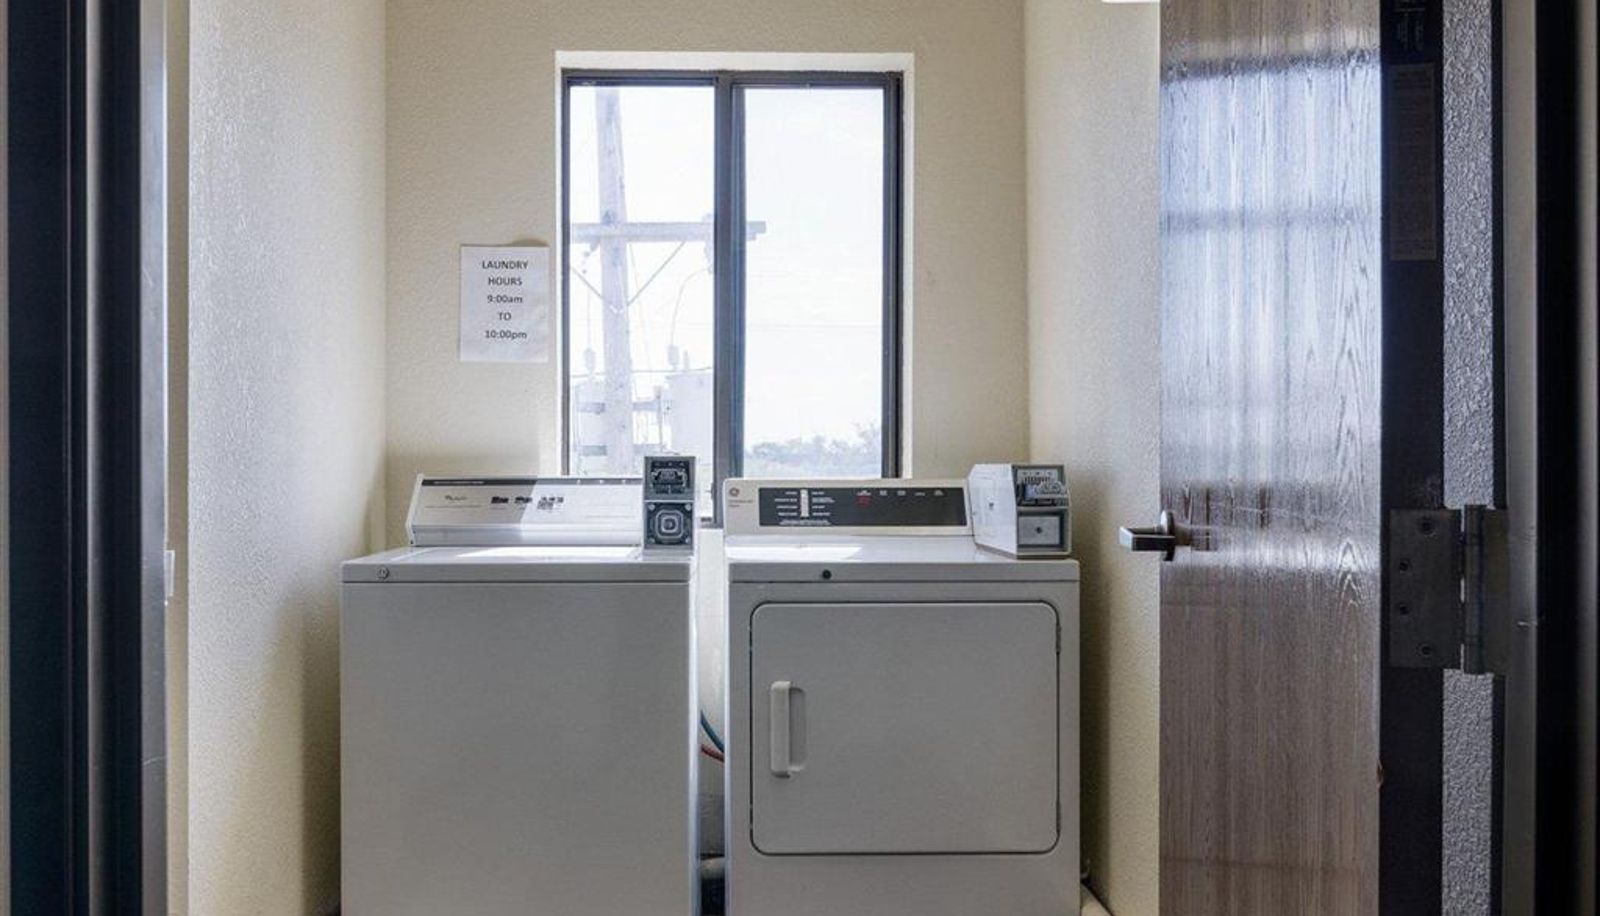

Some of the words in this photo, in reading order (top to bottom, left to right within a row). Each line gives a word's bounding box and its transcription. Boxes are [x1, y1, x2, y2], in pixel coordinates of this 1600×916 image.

[482, 260, 528, 270] LAUNDRY
[488, 277, 523, 286] HOURS
[487, 294, 523, 303] 9:00am
[498, 312, 512, 321] TO
[485, 330, 528, 341] 10:00pm
